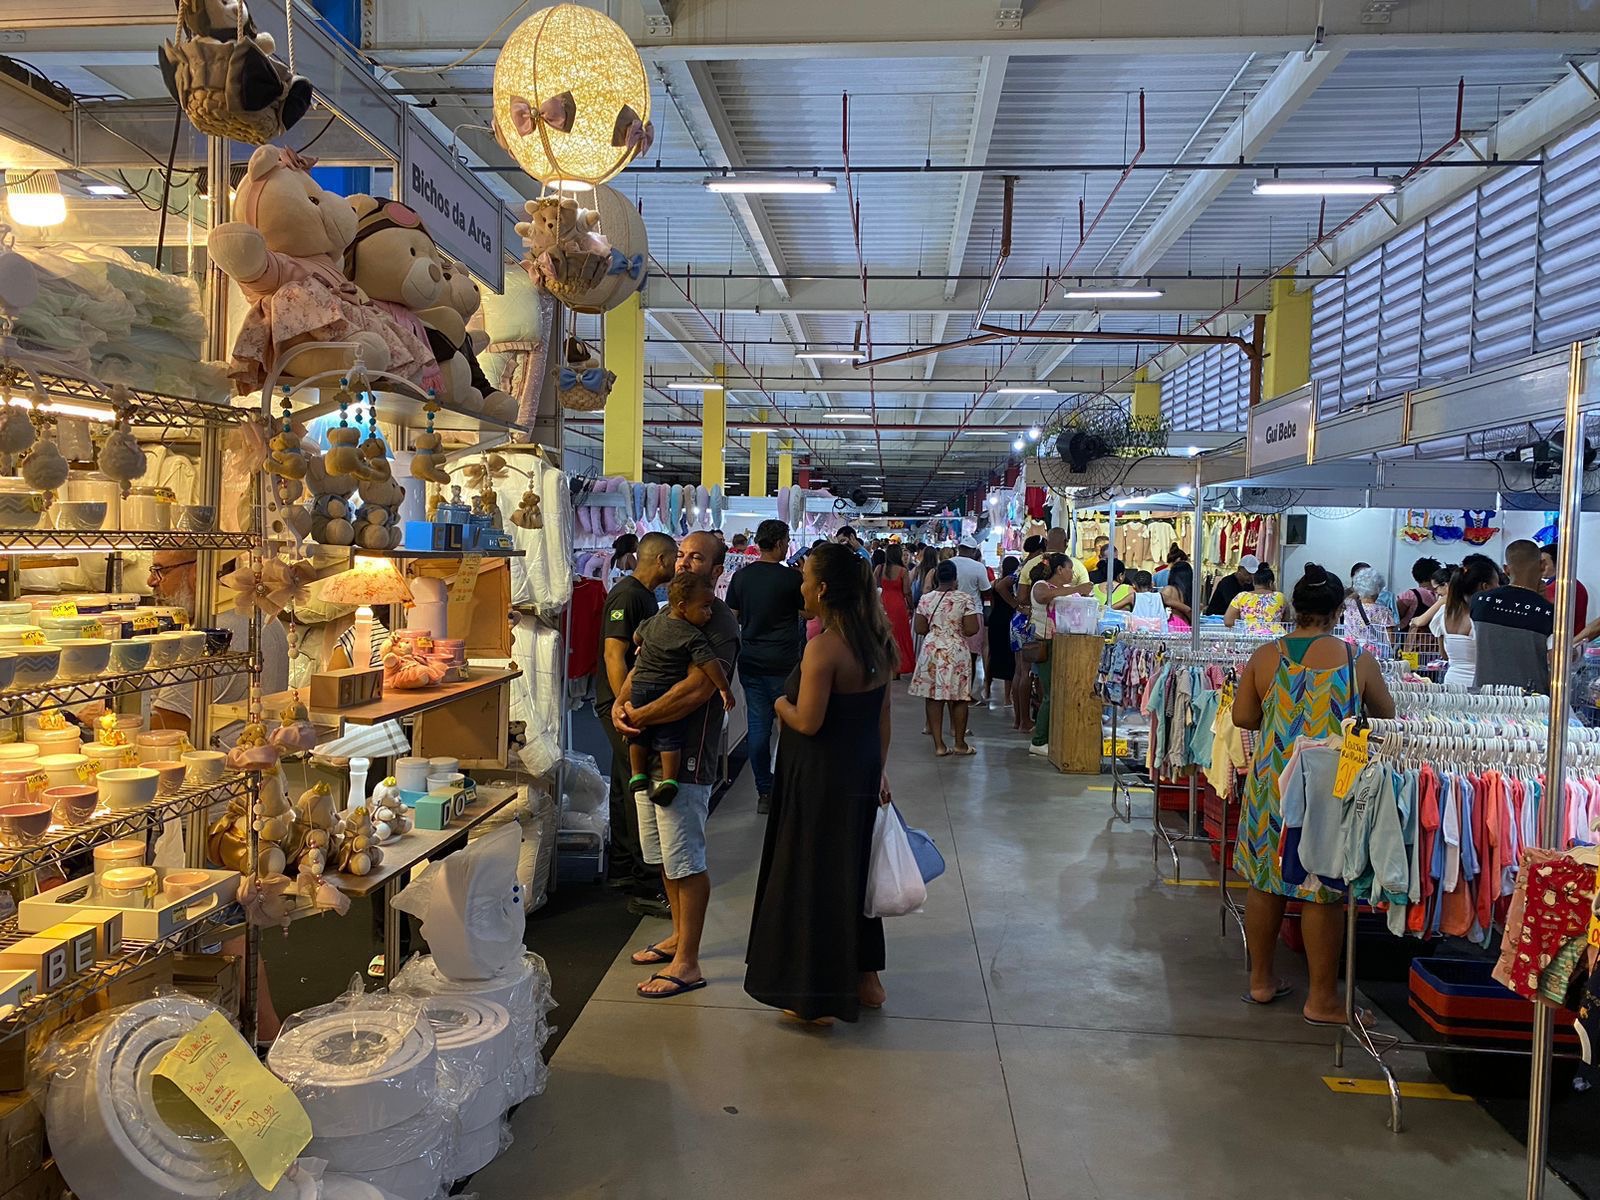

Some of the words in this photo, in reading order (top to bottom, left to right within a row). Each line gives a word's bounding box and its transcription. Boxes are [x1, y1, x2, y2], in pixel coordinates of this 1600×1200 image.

[412, 163, 450, 218] Bichos
[452, 202, 466, 232] da
[468, 215, 492, 254] Arca
[1265, 424, 1278, 445] Gui
[1278, 420, 1297, 441] Bebe
[1478, 596, 1502, 604] NEW
[1514, 602, 1552, 616] YORK
